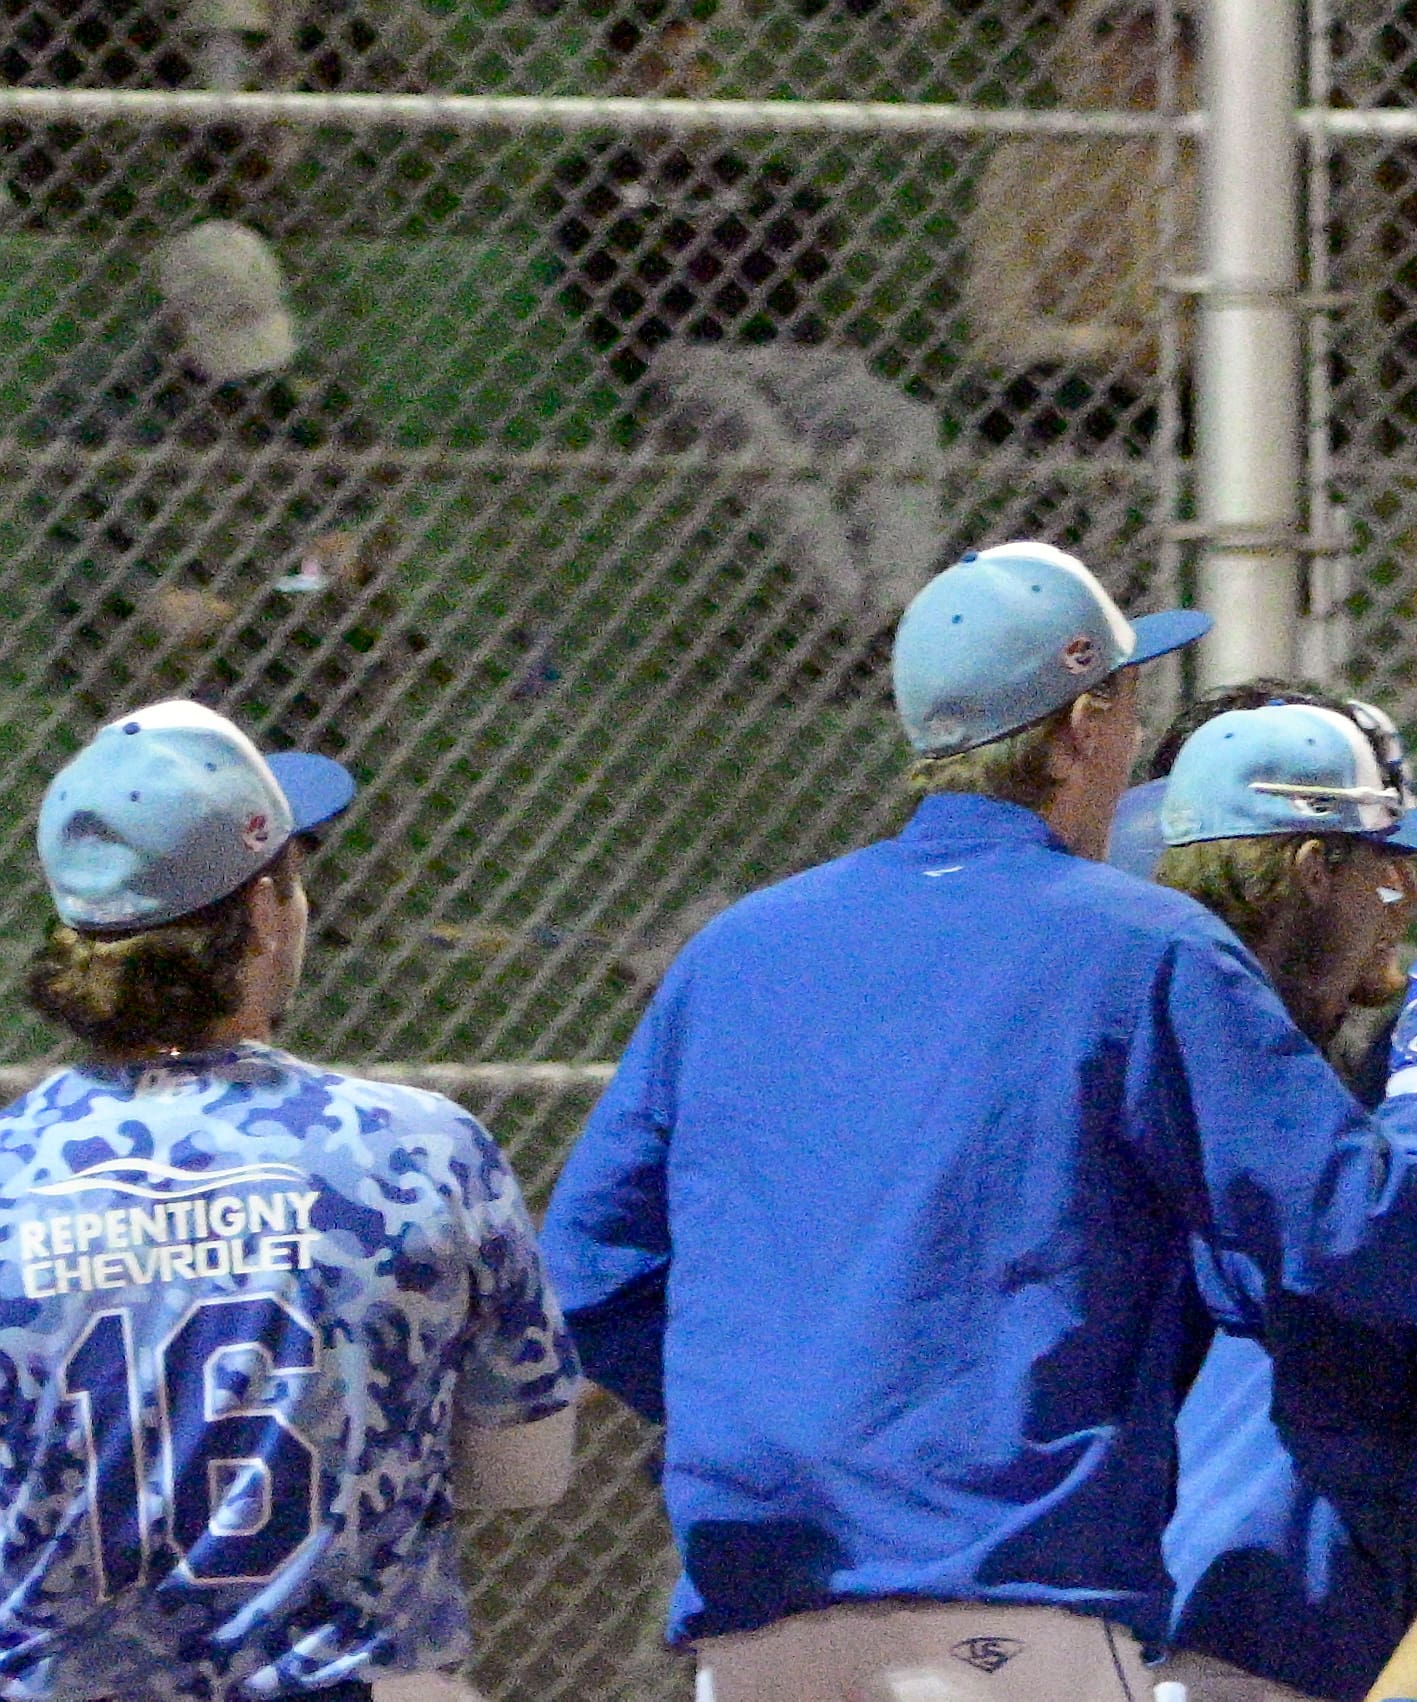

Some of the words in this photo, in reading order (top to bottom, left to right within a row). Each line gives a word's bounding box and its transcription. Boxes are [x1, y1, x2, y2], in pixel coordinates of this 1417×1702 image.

[20, 1191, 320, 1260] REPENTIGNY
[23, 1234, 323, 1299] CHEVROLET
[61, 1291, 323, 1603] 16
